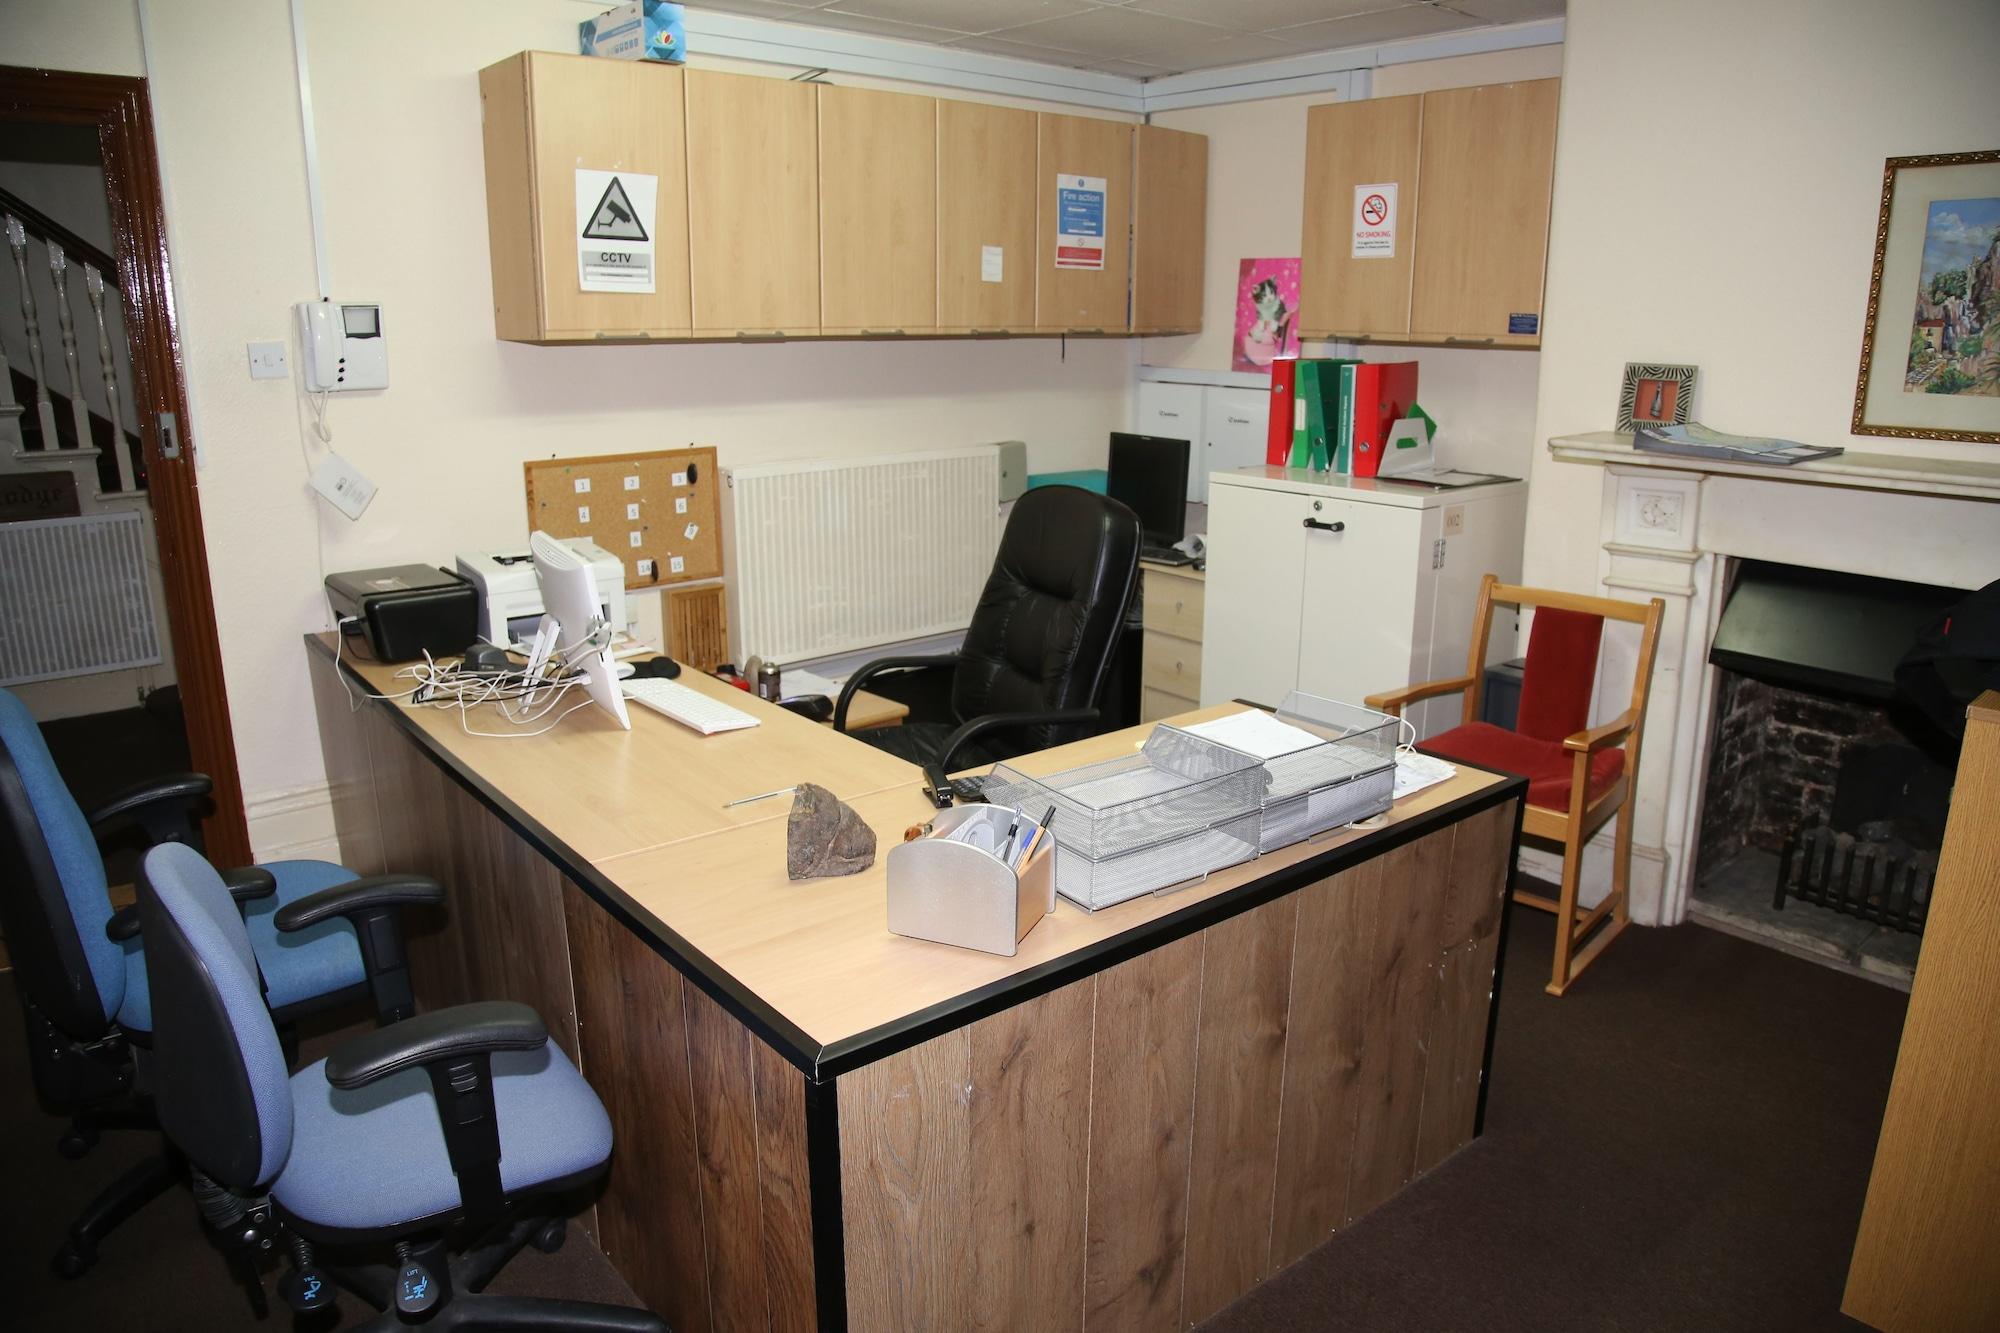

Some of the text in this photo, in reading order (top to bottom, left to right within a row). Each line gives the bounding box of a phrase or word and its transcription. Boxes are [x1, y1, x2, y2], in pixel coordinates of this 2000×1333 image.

[1365, 230, 1391, 238] SMOKING
[601, 252, 632, 263] CCTV
[678, 502, 684, 510] 6
[407, 1268, 419, 1277] LIFT
